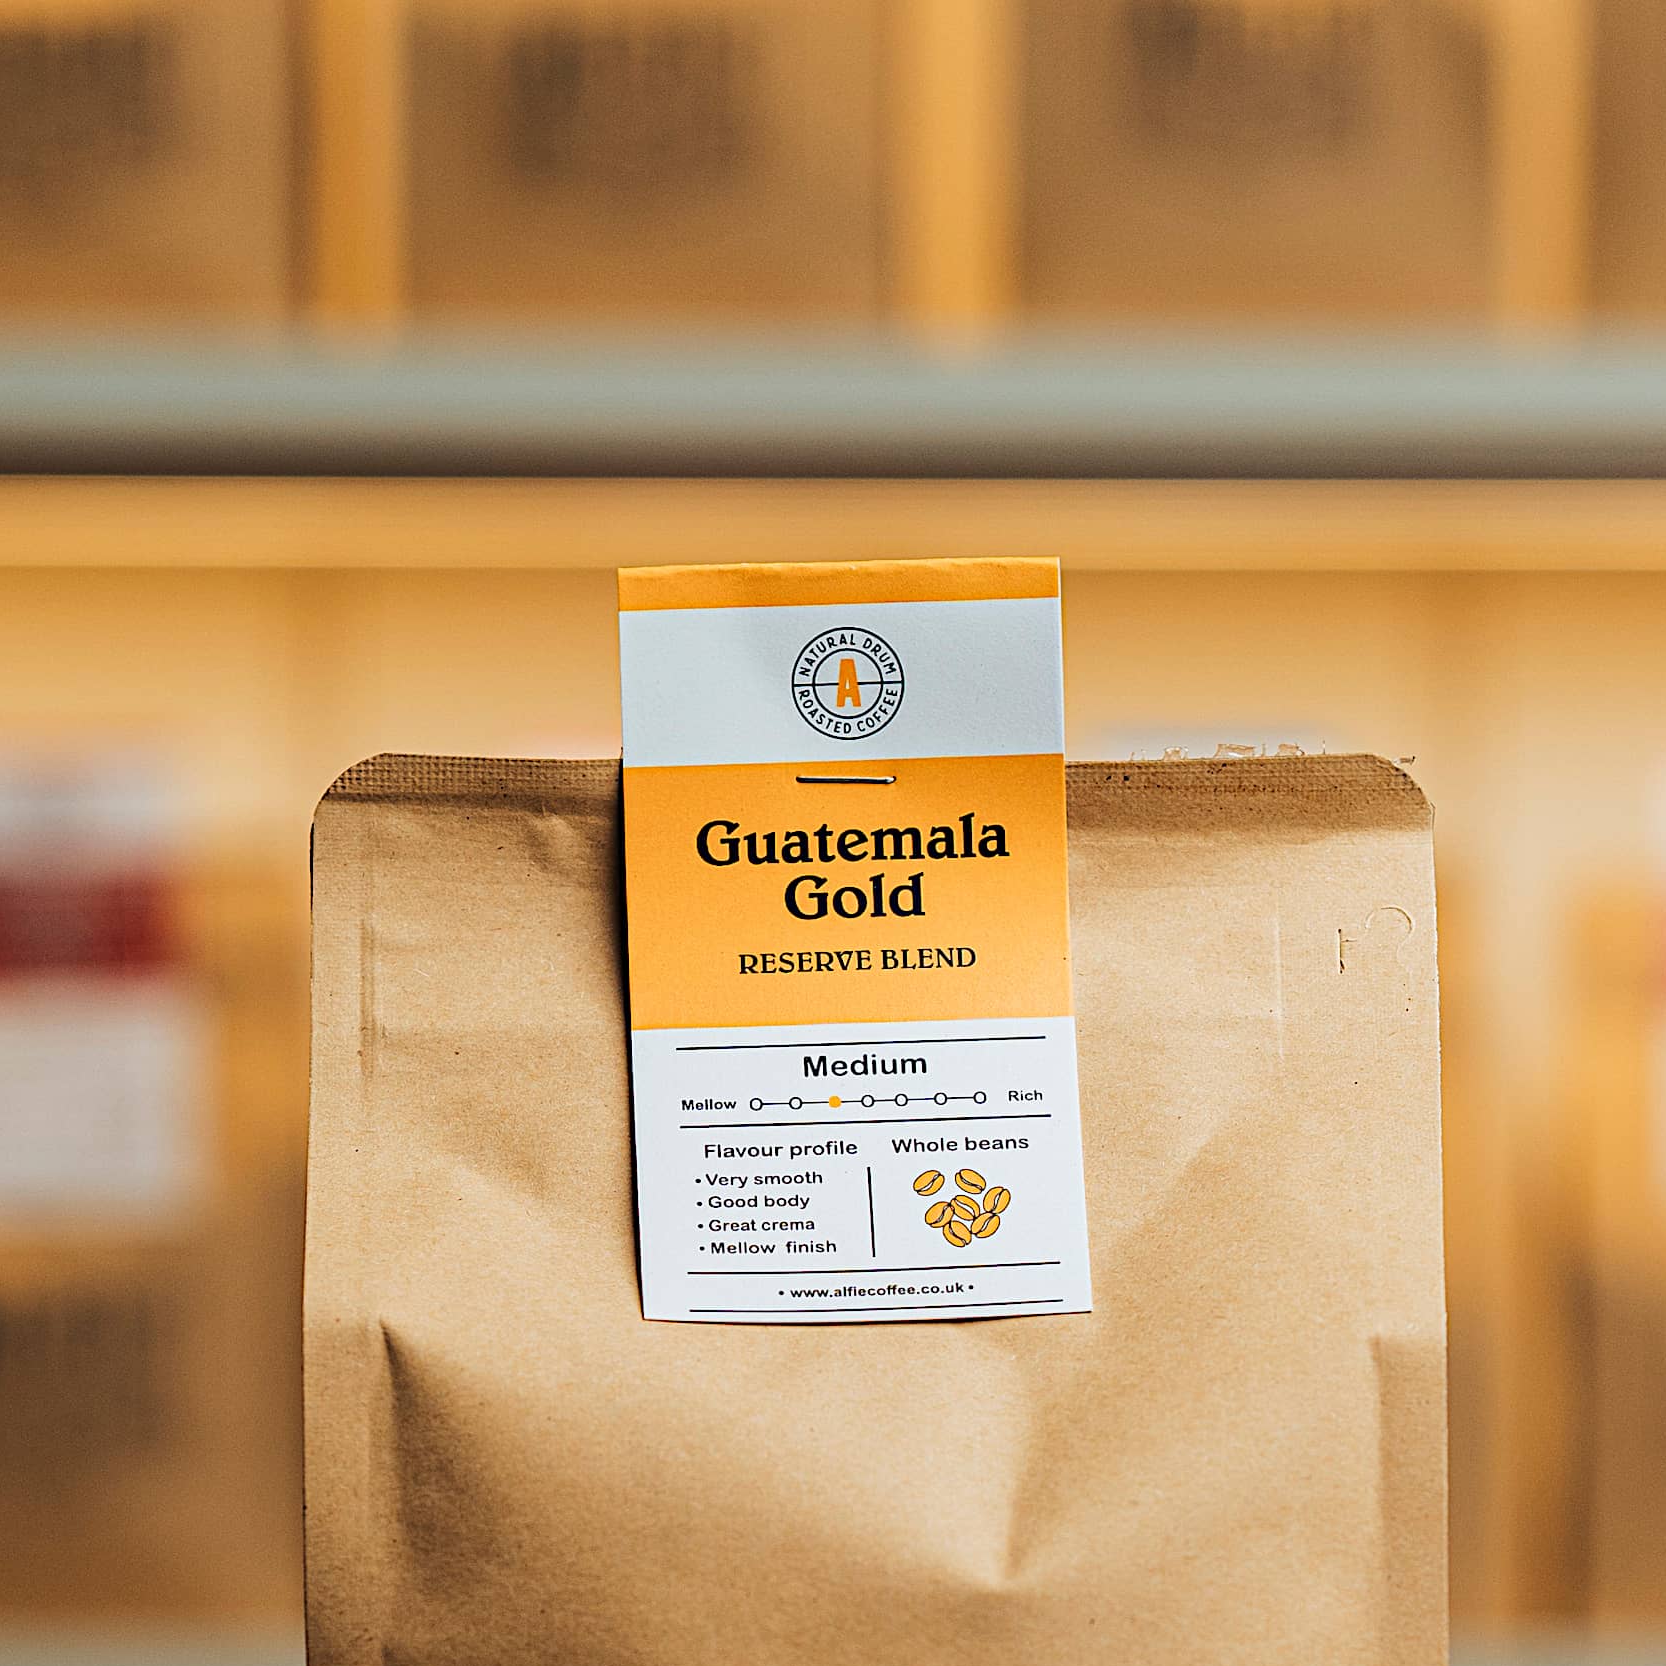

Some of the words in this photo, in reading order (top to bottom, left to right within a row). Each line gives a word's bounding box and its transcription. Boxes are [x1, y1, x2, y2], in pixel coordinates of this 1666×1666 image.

[799, 632, 857, 677] NATURAL
[862, 636, 897, 676] DRUM
[836, 658, 862, 708] A
[798, 688, 852, 735] ROASTED
[856, 688, 898, 733] COFFEE
[696, 812, 1010, 867] Guatemala
[784, 872, 925, 920] Gold
[738, 950, 873, 974] RESERVE
[881, 947, 977, 970] BLEND
[802, 1054, 928, 1078] Medium
[681, 1098, 737, 1111] Mellow
[1007, 1088, 1044, 1102] Rich
[704, 1141, 783, 1159] Flavour
[789, 1140, 858, 1161] profile
[892, 1137, 958, 1154] Whole
[965, 1136, 1029, 1152] beans
[706, 1173, 748, 1189] Very
[753, 1170, 823, 1186] smooth
[708, 1194, 760, 1209] Good
[764, 1194, 810, 1210] body
[708, 1218, 758, 1233] Great
[761, 1219, 816, 1231] crema
[710, 1241, 776, 1255] Mellow
[786, 1239, 837, 1254] finish
[790, 1281, 964, 1299] www.alfiecoffee.co.uk
